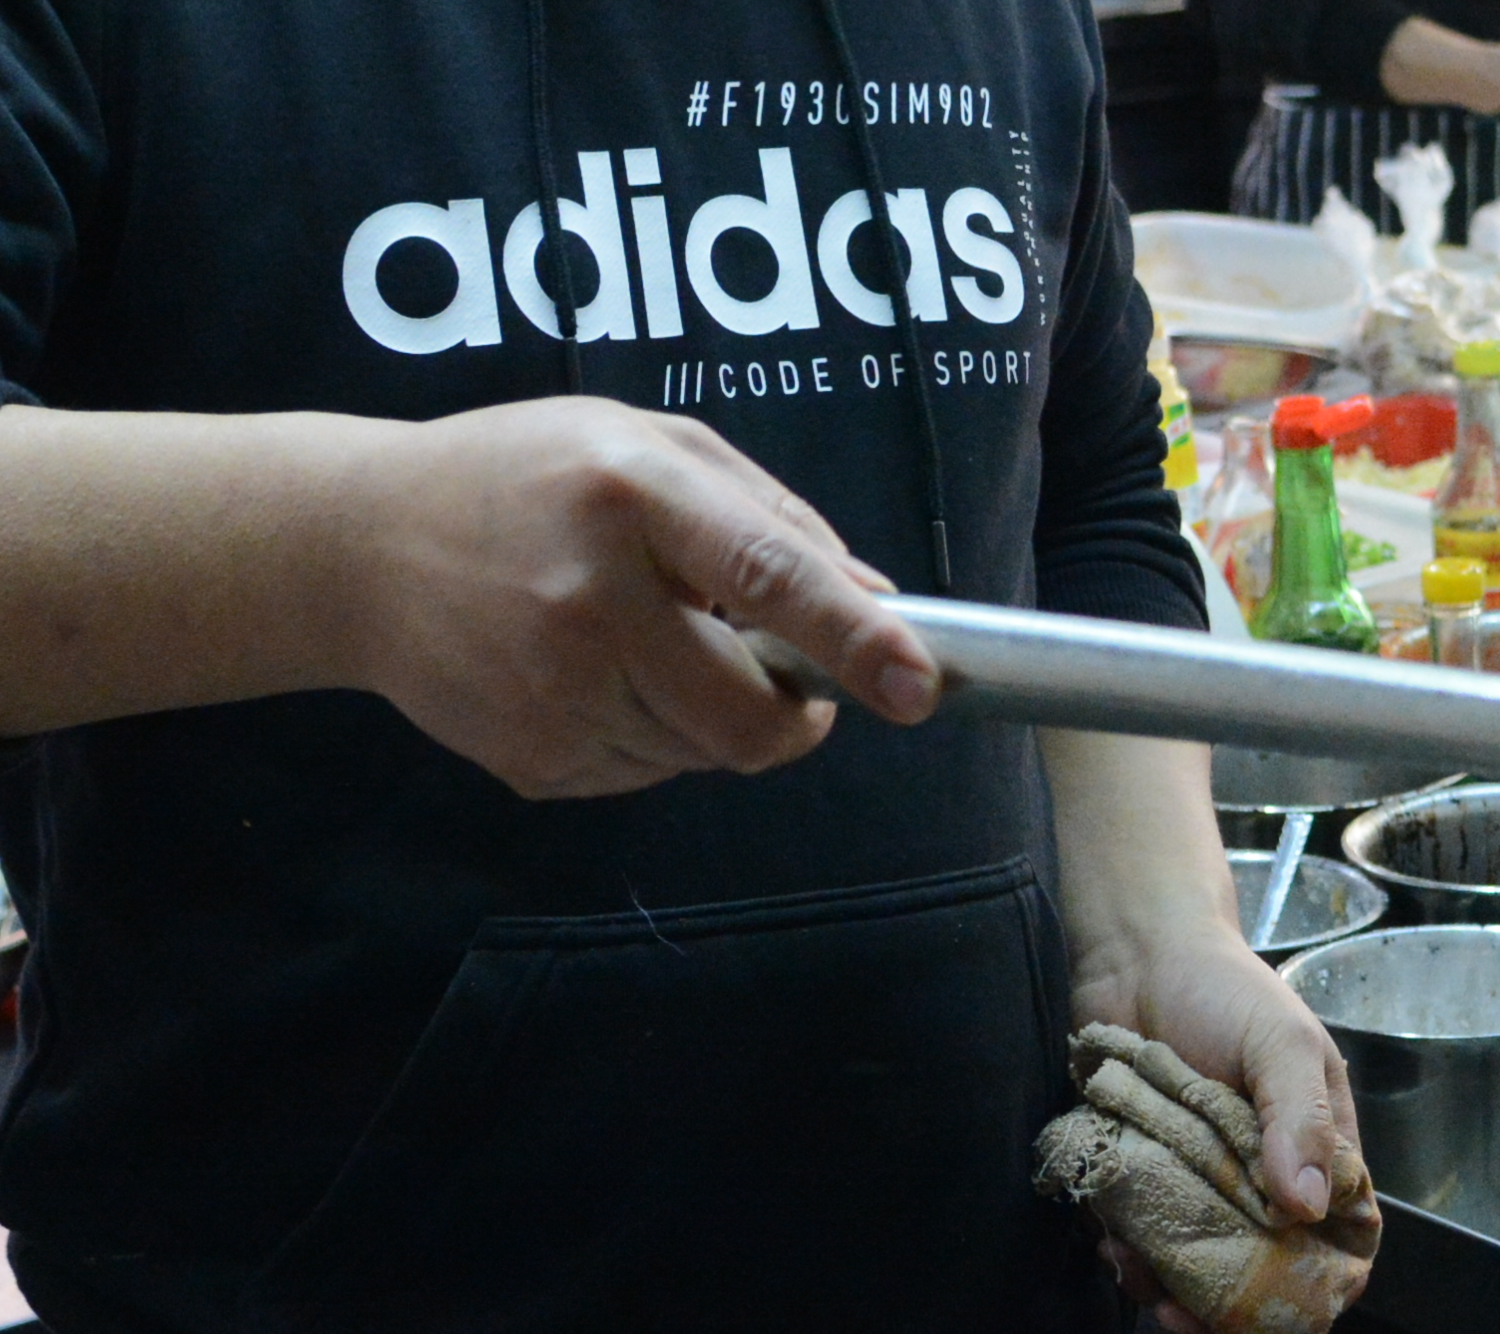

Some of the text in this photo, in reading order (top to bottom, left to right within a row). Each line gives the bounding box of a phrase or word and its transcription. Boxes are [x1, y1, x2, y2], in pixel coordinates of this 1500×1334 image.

[342, 147, 1025, 355] adidas
[861, 353, 905, 389] OF
[933, 350, 1031, 386] SPORT
